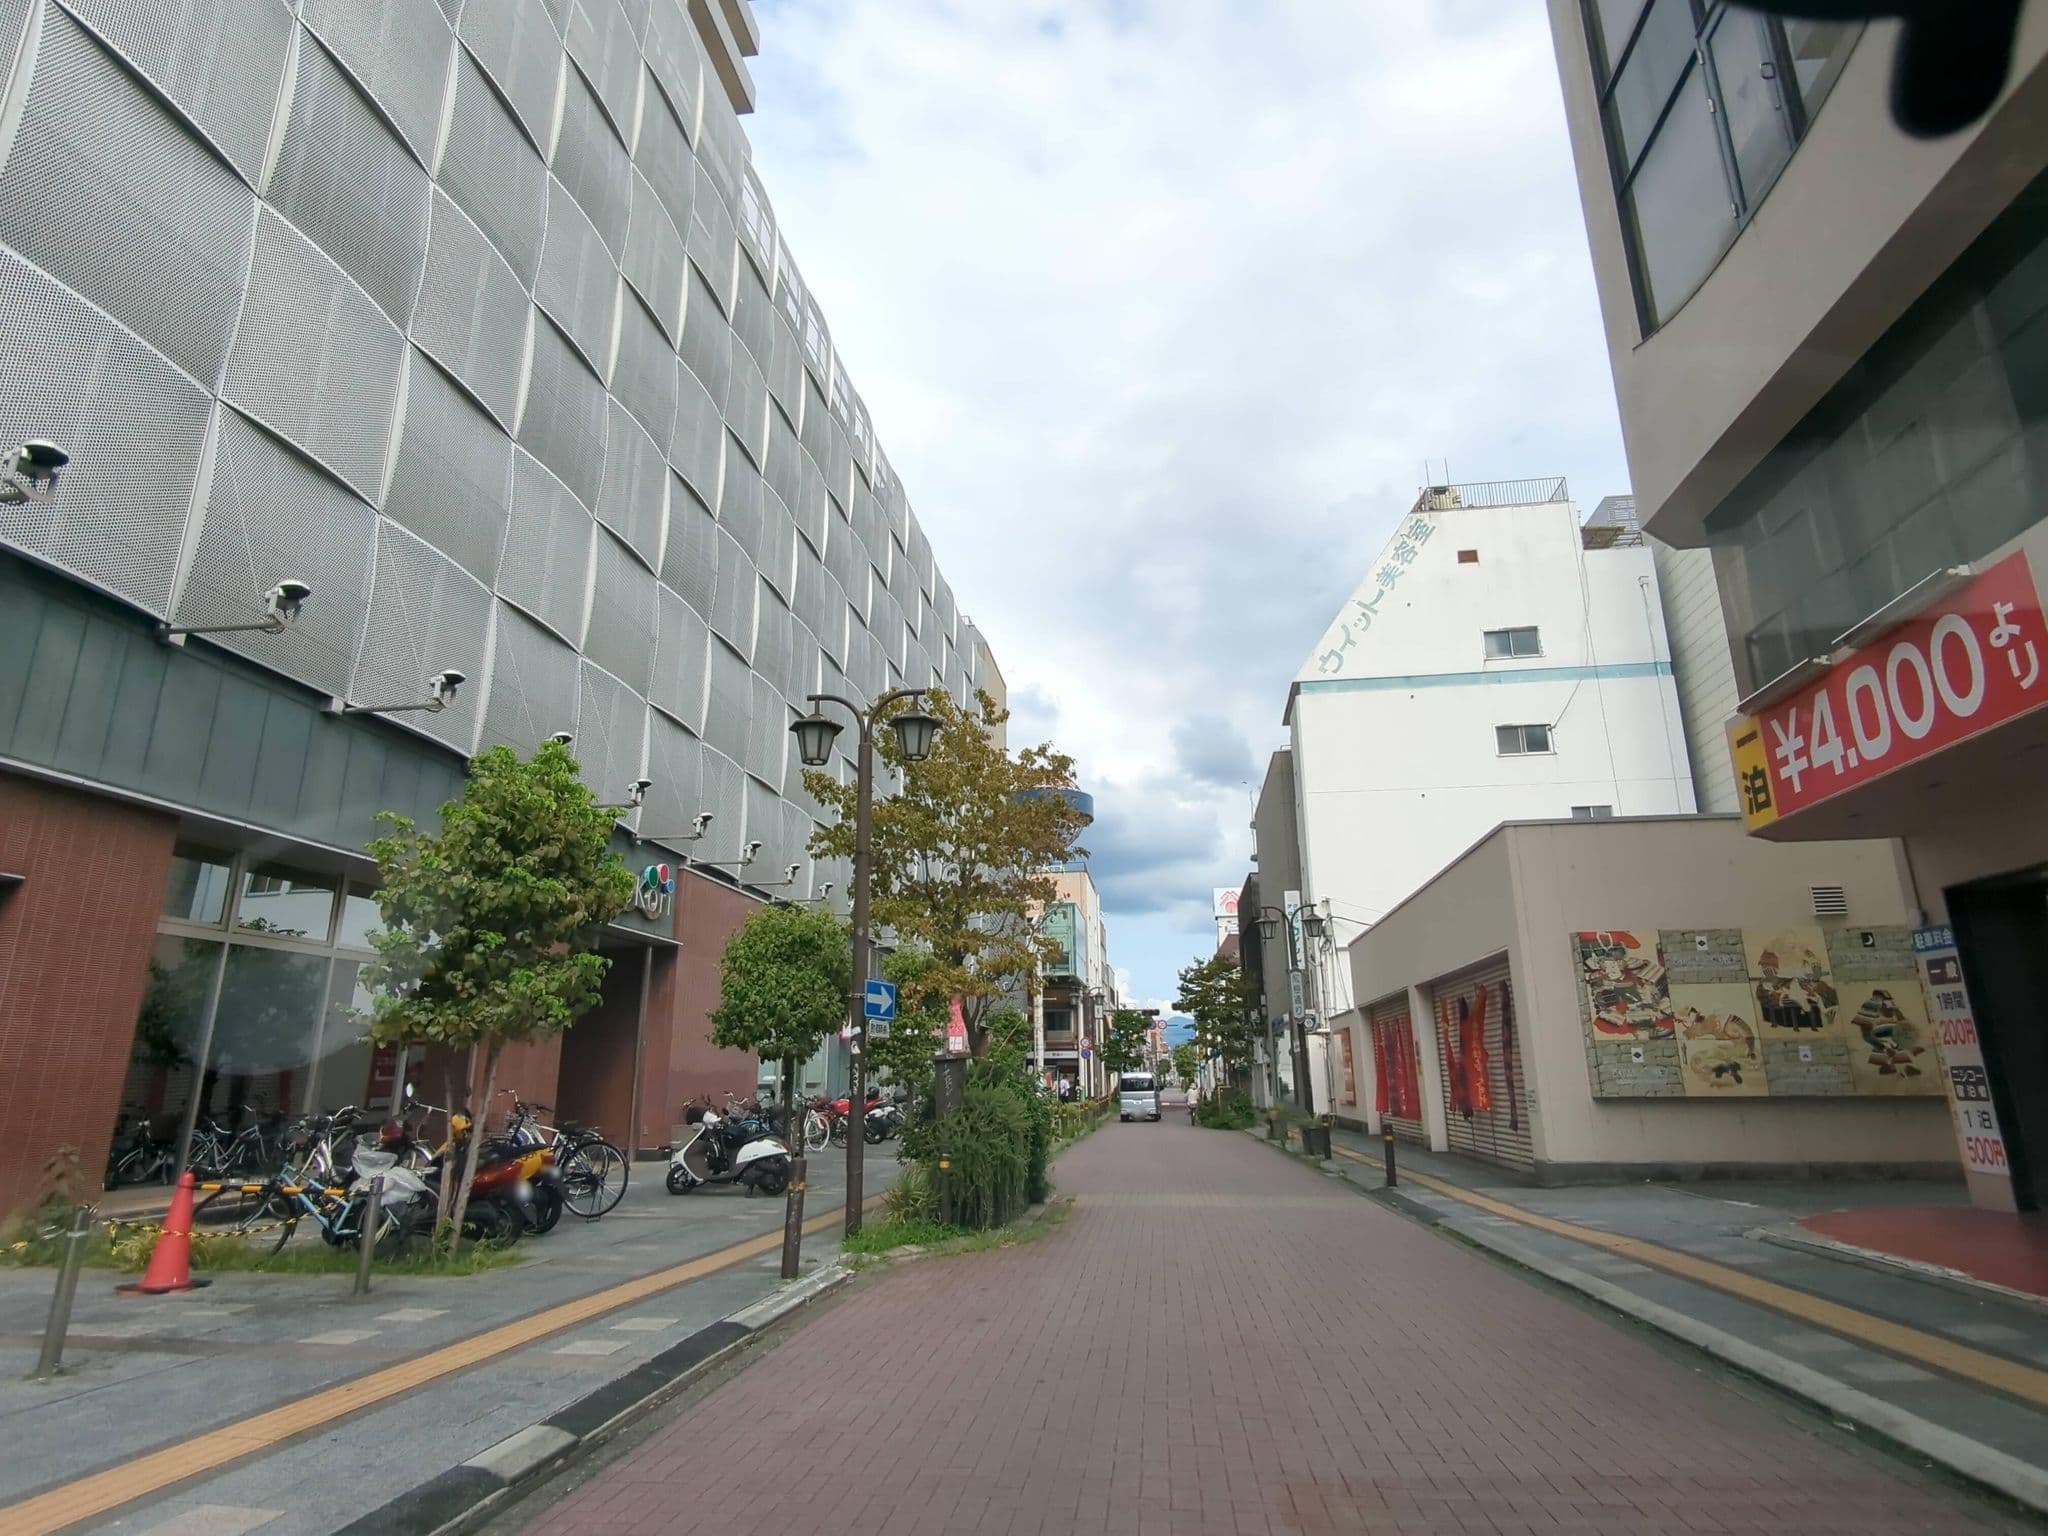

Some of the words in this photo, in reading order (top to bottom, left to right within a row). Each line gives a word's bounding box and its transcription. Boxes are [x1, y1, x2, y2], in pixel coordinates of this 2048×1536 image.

[1989, 601, 2040, 690] より
[1736, 730, 1773, 815] 一泊
[1914, 927, 1954, 949] 駐車料金
[1936, 991, 1966, 1010] 1時間
[1940, 1017, 1976, 1046] 200円
[1966, 1137, 2006, 1168] 500円
